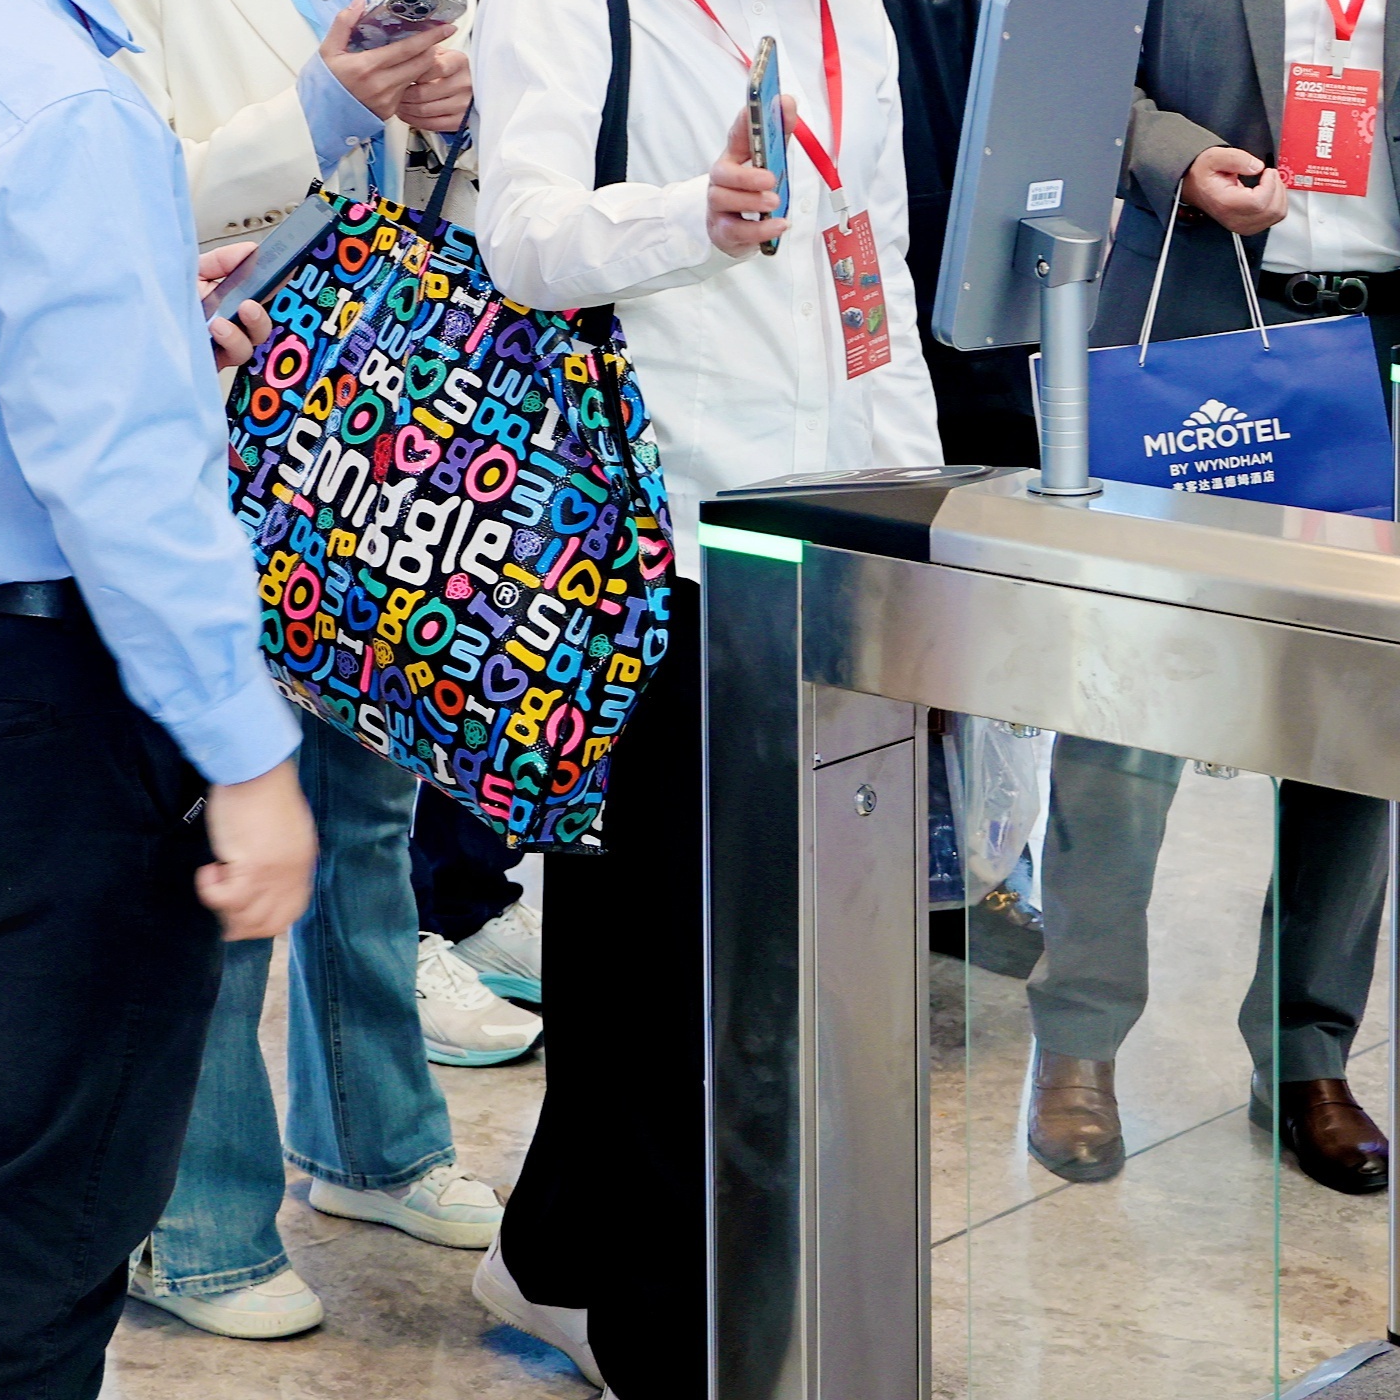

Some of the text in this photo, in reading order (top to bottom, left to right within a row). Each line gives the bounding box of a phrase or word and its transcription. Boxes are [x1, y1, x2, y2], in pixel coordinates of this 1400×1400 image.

[1295, 81, 1323, 93] 2025
[1316, 110, 1336, 159] 展商证
[1143, 417, 1291, 458] MICROTEL
[1169, 451, 1273, 477] BY WYNDHAM
